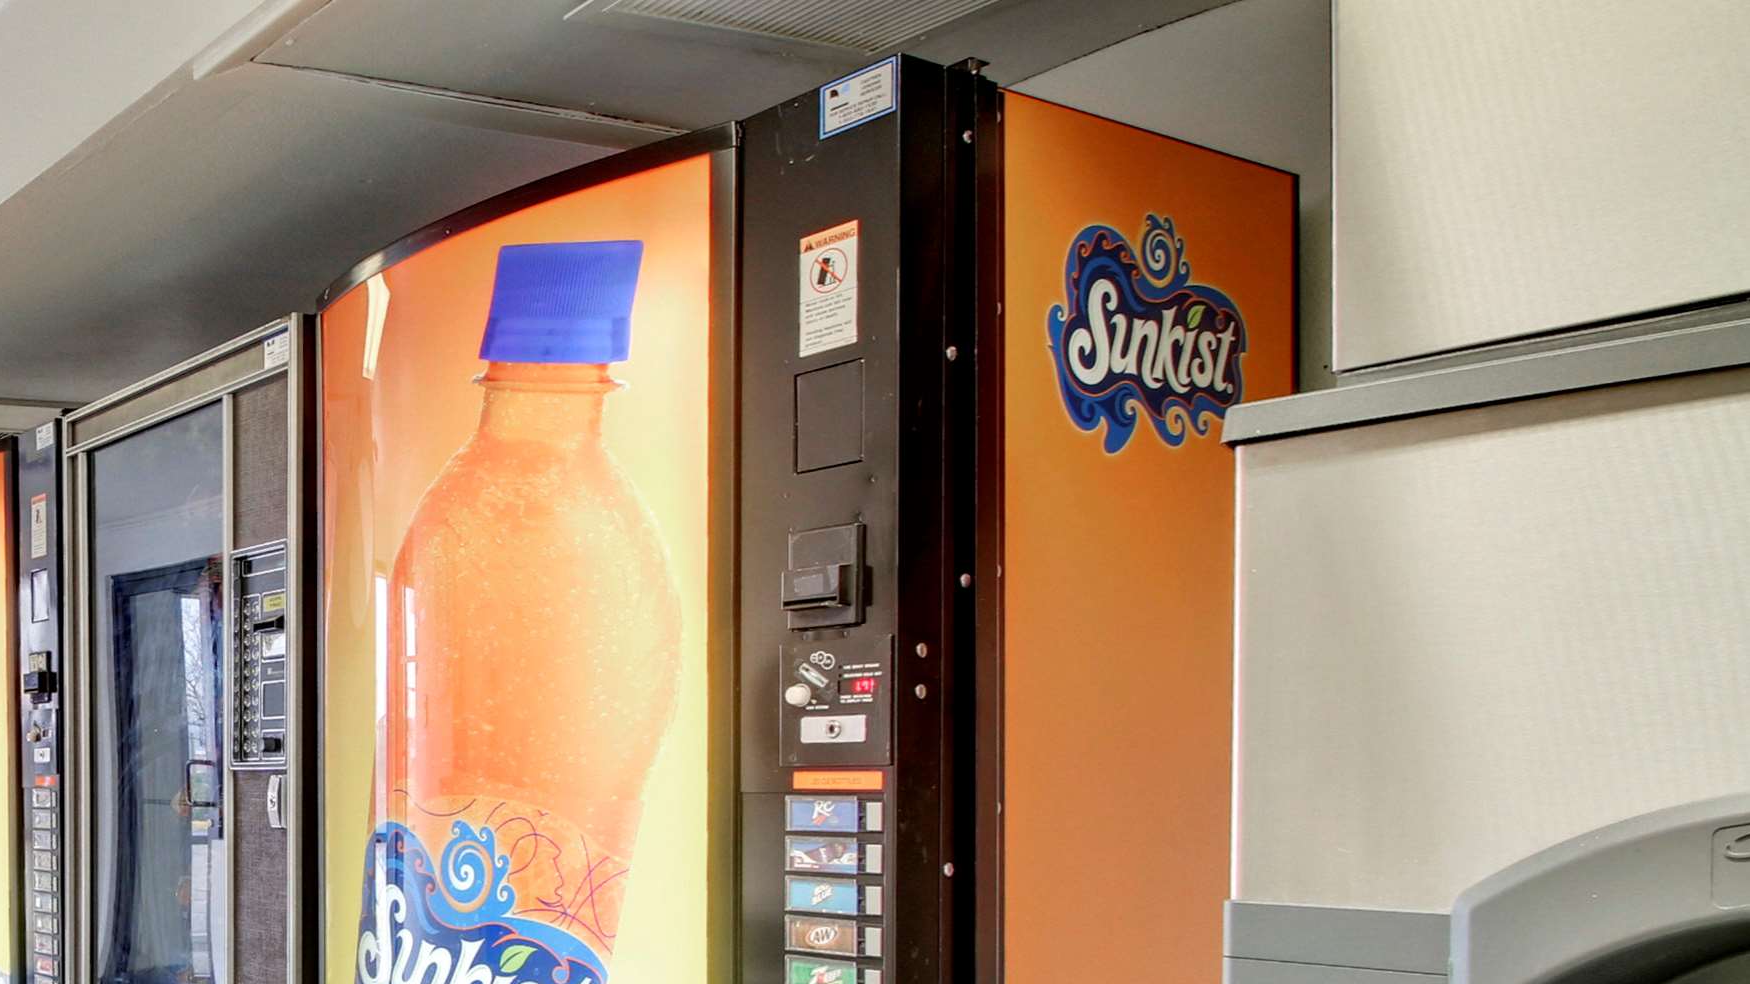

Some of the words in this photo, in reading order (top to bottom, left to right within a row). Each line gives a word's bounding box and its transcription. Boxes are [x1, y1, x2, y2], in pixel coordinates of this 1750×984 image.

[815, 227, 857, 249] WARNING
[1068, 278, 1237, 394] Sunkist
[812, 800, 836, 819] RC
